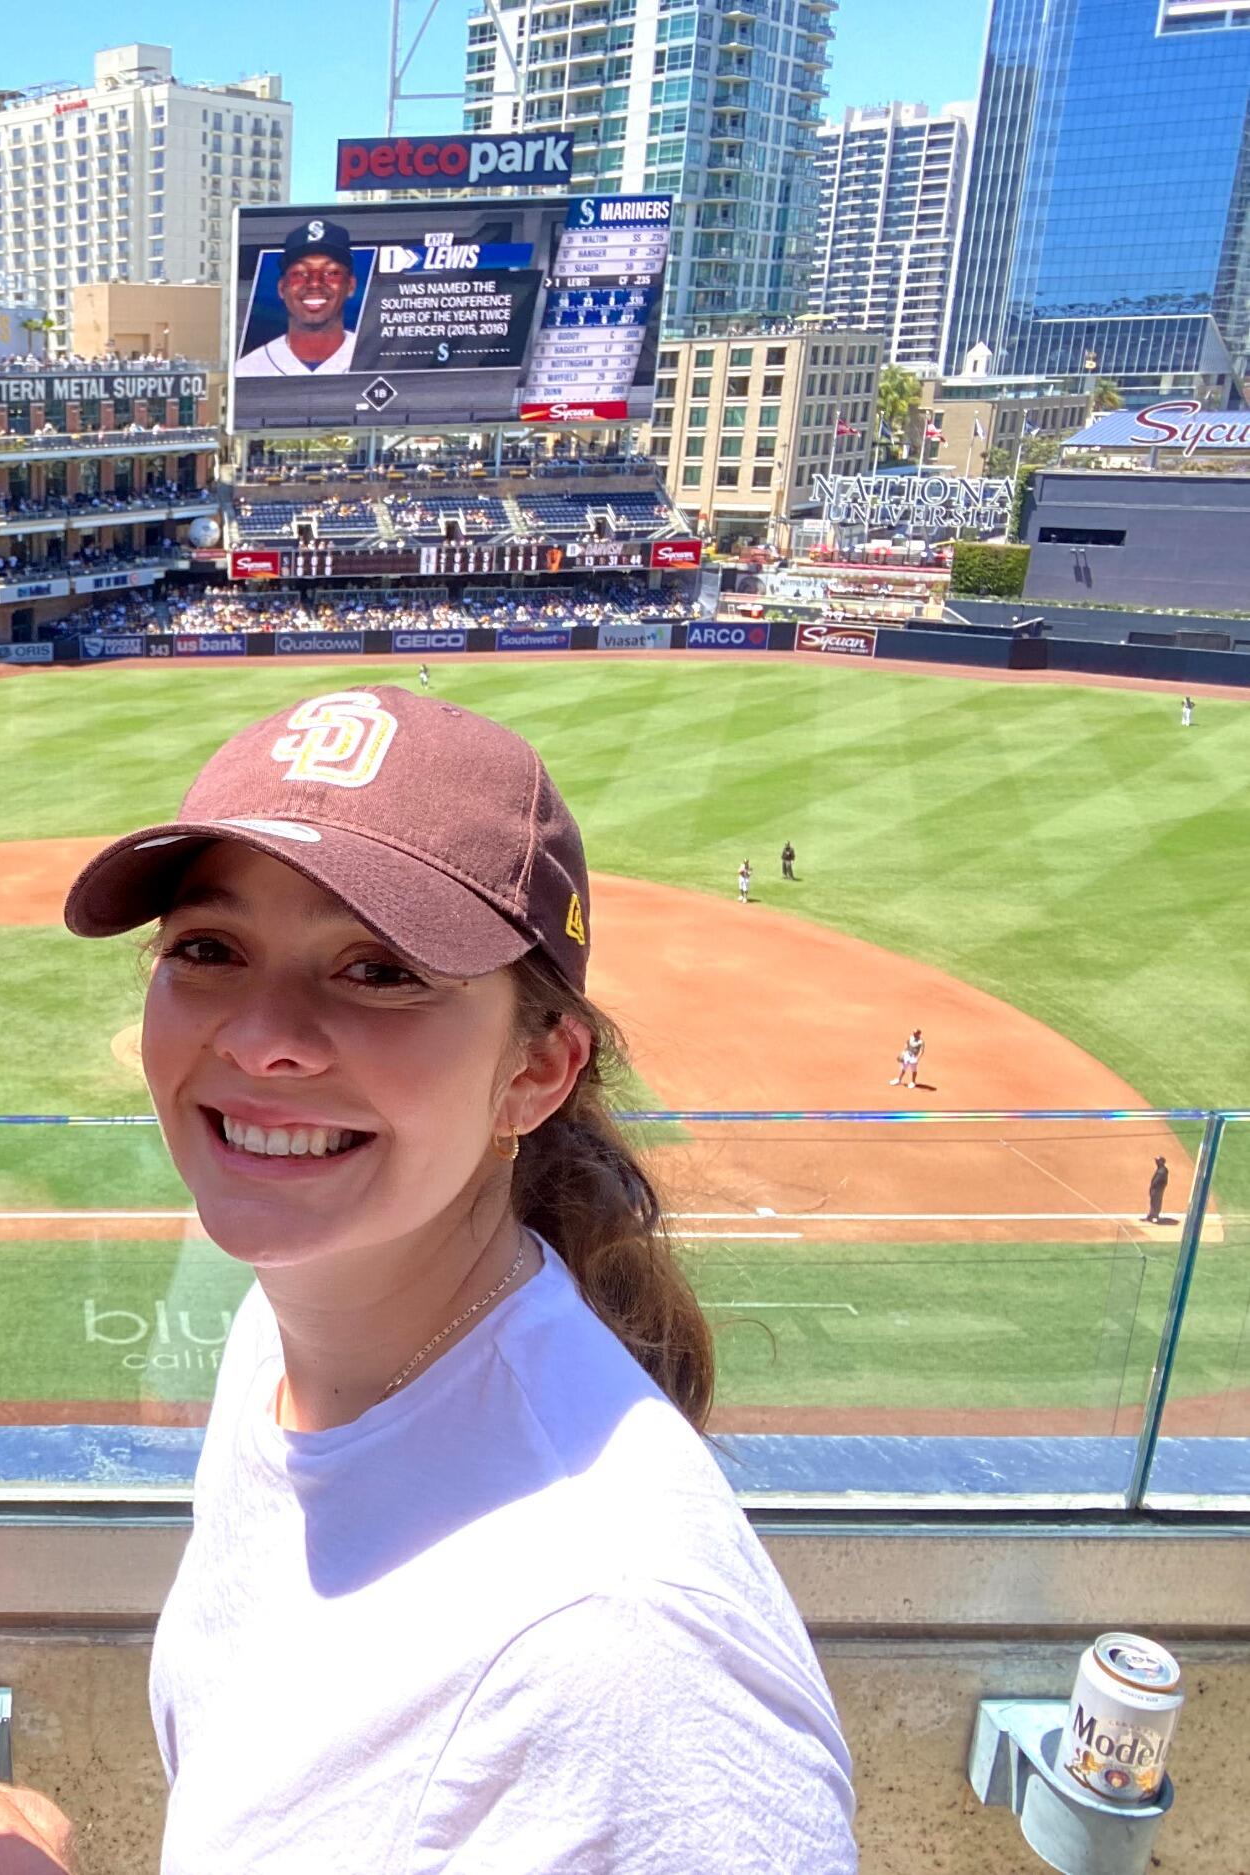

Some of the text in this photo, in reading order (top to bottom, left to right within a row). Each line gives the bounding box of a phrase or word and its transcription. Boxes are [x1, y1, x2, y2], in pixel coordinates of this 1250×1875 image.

[599, 201, 670, 221] MARINERS
[423, 245, 481, 269] LEWIS
[399, 281, 496, 295] WAS NAMED THE
[567, 277, 590, 287] LEWIS
[380, 295, 512, 310] SOUTHERN CONFERENCE
[380, 309, 510, 324] PLAYER OF THE YEAR TWICE
[380, 322, 508, 338] AT MERCER (2015, 2016)
[53, 377, 110, 400] METAL
[113, 376, 175, 398] SUPPLY
[180, 375, 206, 396] CO.
[549, 404, 595, 420] Sycuan
[631, 555, 642, 565] 44
[278, 636, 360, 651] Qualcomm
[395, 633, 464, 648] GEICO
[501, 634, 557, 646] Southwest
[604, 634, 647, 647] Viasat
[689, 628, 746, 644] ARCO
[801, 627, 866, 652] Sycuan
[14, 644, 51, 657] ORIS
[150, 644, 169, 656] 343
